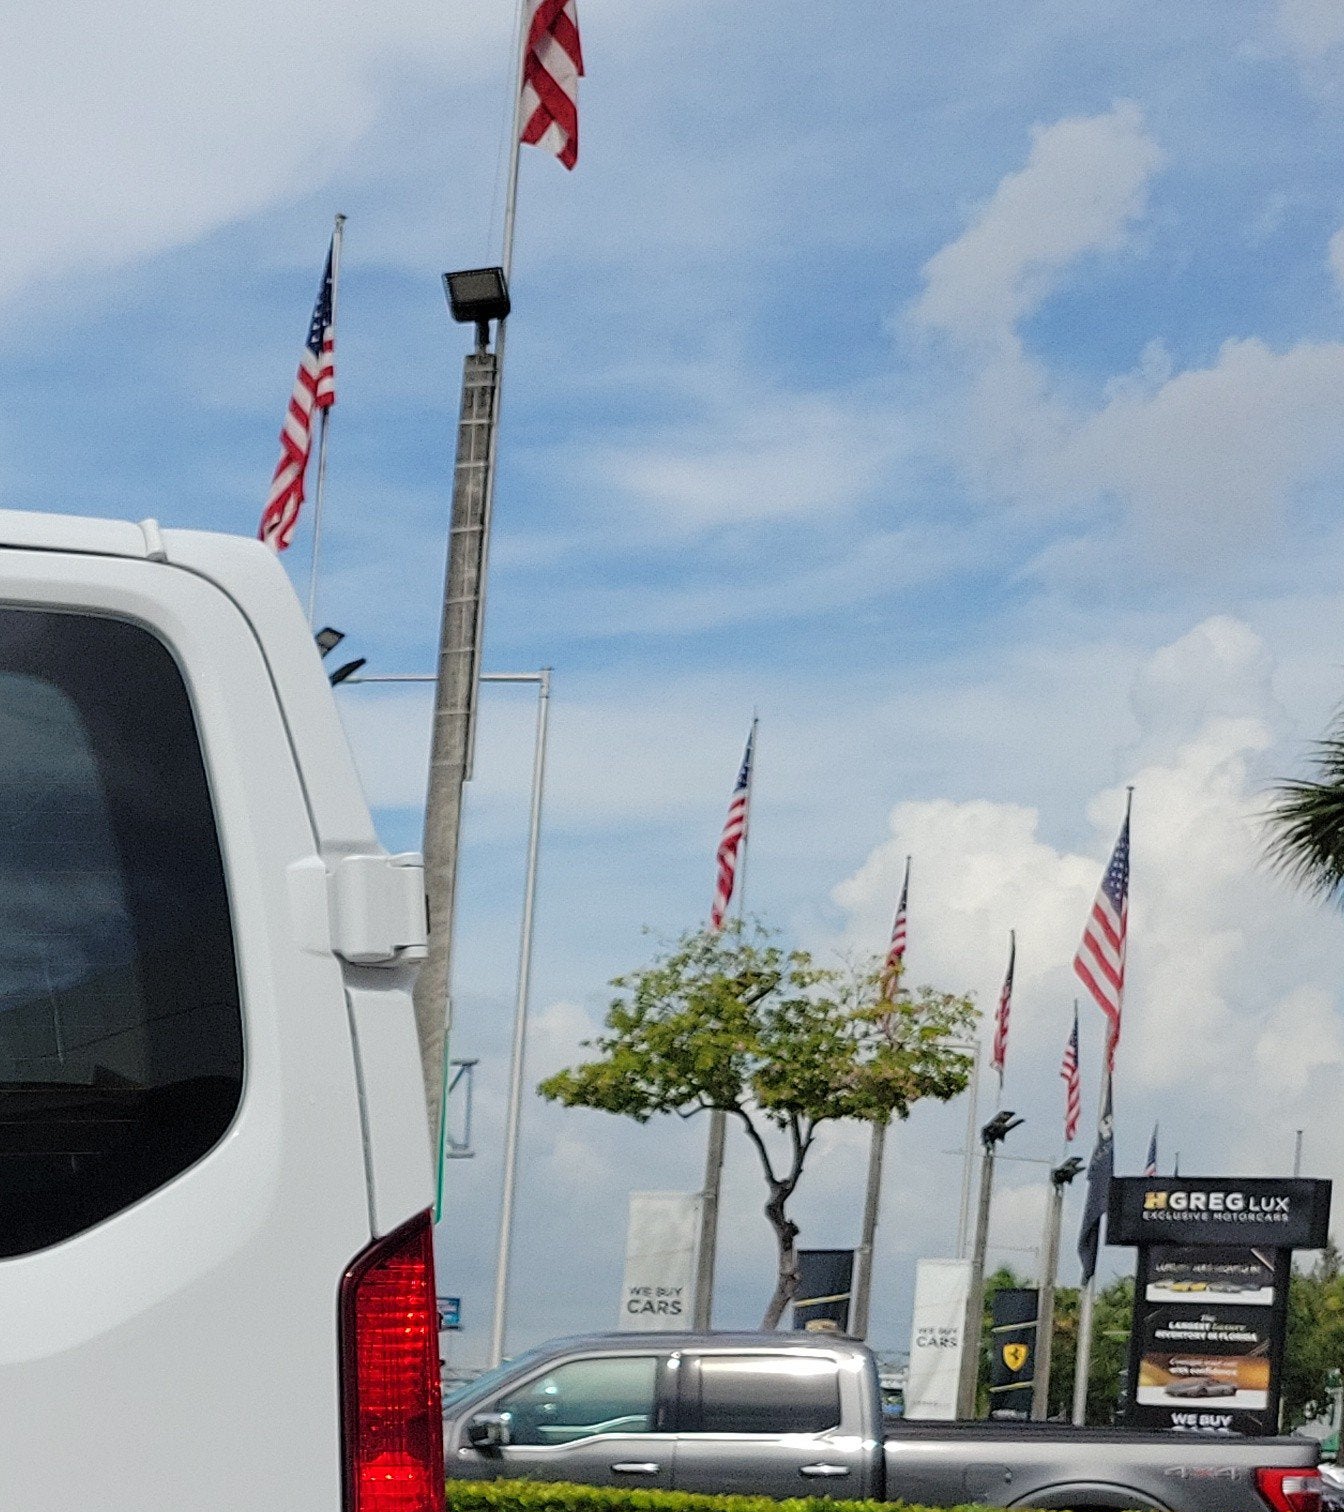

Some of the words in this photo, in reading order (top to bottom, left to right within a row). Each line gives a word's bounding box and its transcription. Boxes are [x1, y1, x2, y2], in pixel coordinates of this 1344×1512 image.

[1249, 1196, 1290, 1213] LUX
[1142, 1211, 1209, 1221] EXCLUSIVE
[1213, 1211, 1289, 1222] MOTORCARS
[630, 1286, 652, 1296] WE
[656, 1286, 683, 1297] BUY
[627, 1299, 682, 1315] CARS
[916, 1336, 958, 1348] CARS
[1171, 1413, 1198, 1426] WE
[1199, 1414, 1233, 1428] BUY
